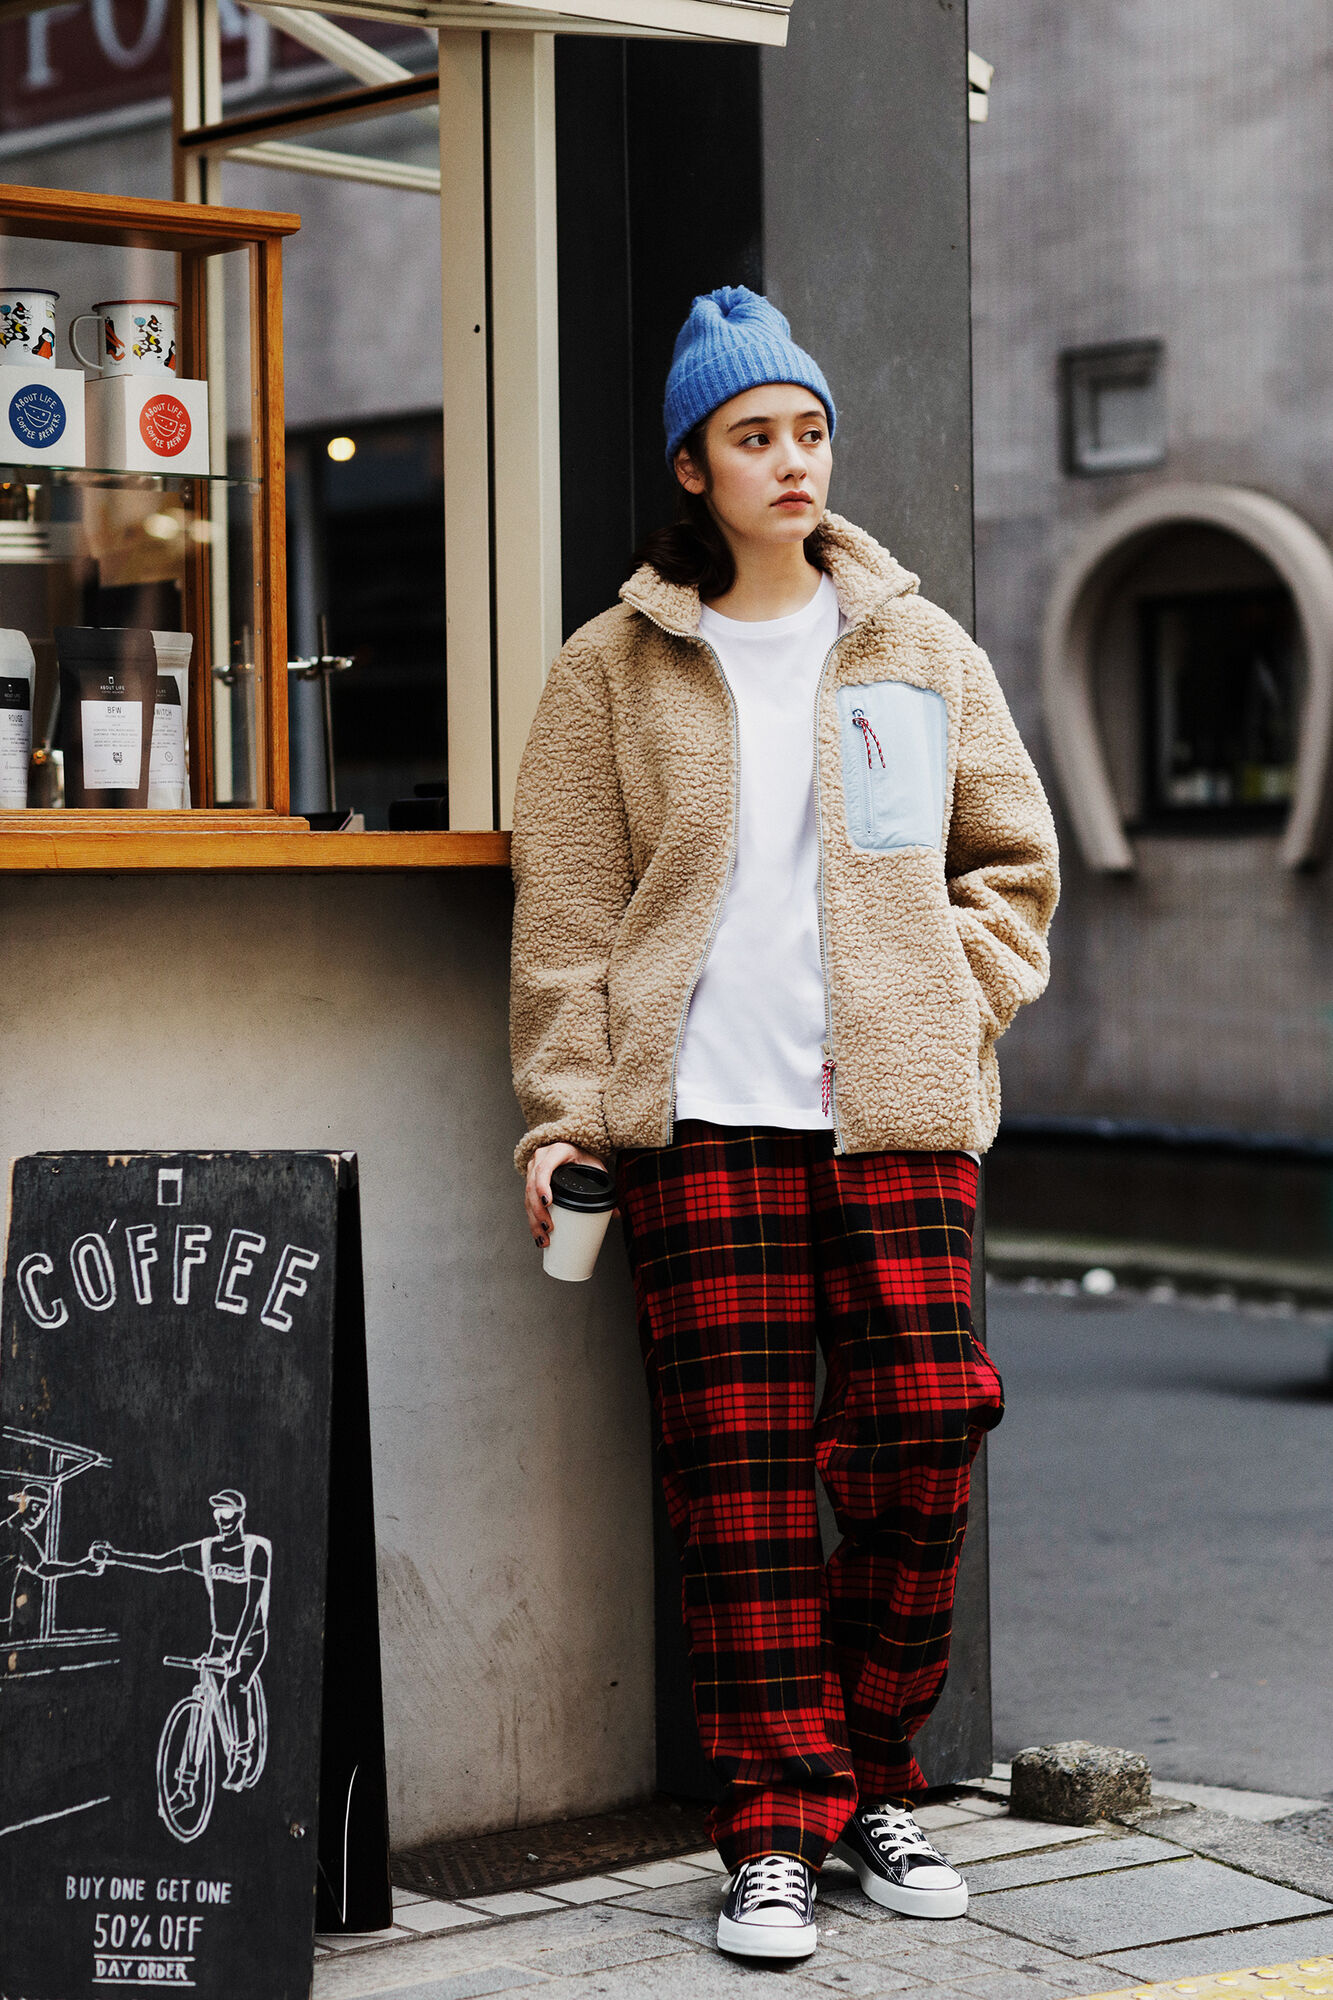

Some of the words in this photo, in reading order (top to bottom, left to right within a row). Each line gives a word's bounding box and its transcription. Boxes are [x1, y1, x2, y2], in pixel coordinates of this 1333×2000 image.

[15, 393, 37, 411] ABOUT
[40, 394, 57, 409] LIFE
[145, 403, 165, 420] ABOUT
[167, 403, 183, 419] LIFE
[17, 416, 36, 440] COFFEE
[38, 414, 61, 441] BREWERS
[146, 425, 164, 449] COFFEE
[166, 423, 187, 450] BREWERS
[66, 1875, 105, 1900] BUY
[110, 1877, 146, 1901] ONE
[156, 1878, 191, 1903] GET
[196, 1880, 232, 1904] ONE
[93, 1913, 152, 1949] 50%
[159, 1915, 205, 1951] OFF
[95, 1959, 133, 1978] DAY
[137, 1962, 188, 1981] ORDER
